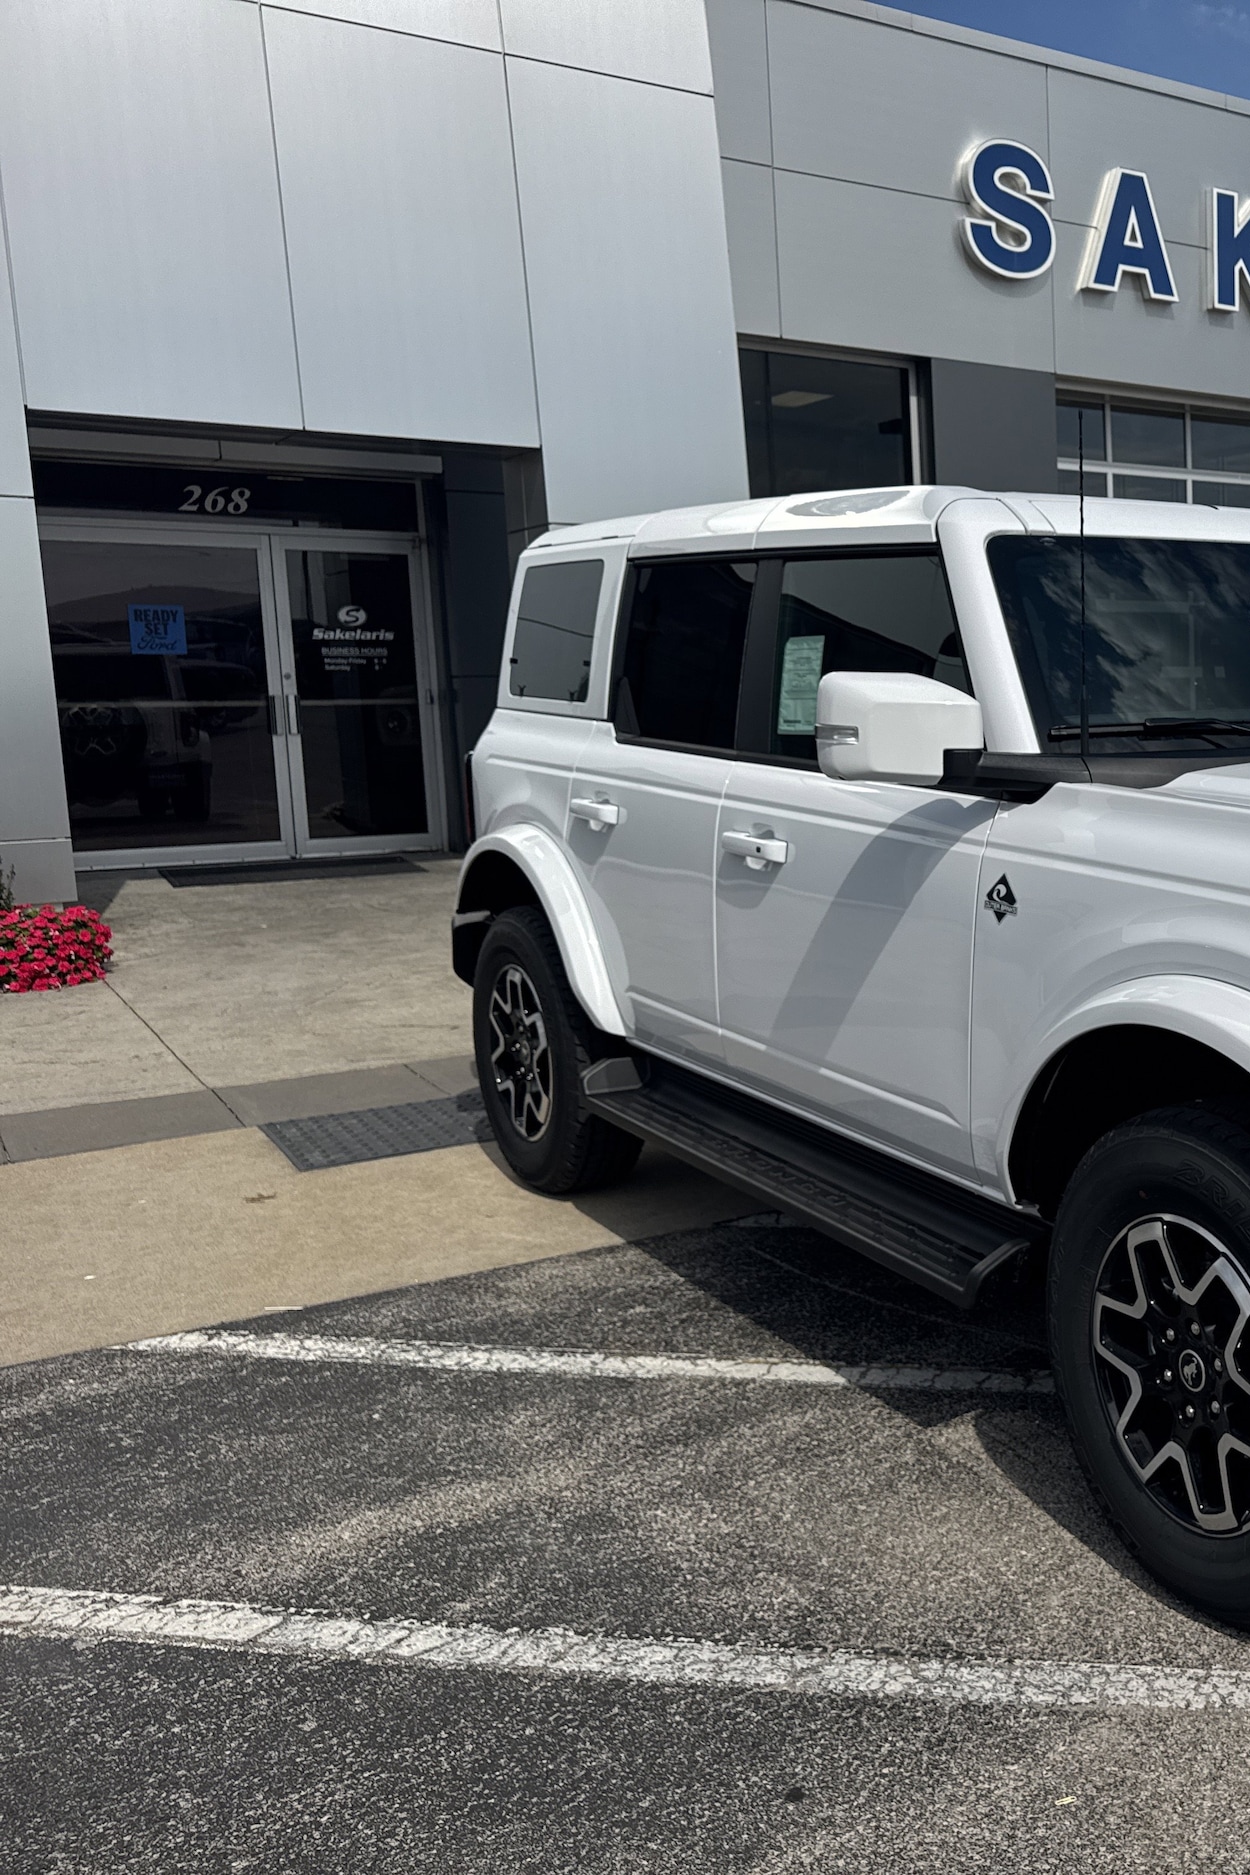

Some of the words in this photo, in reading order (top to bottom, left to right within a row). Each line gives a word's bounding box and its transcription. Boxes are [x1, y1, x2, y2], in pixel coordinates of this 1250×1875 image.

[178, 485, 251, 515] 268
[133, 608, 178, 623] READY
[144, 622, 168, 636] SET
[312, 627, 395, 640] Sakelaris
[137, 636, 178, 650] Ford
